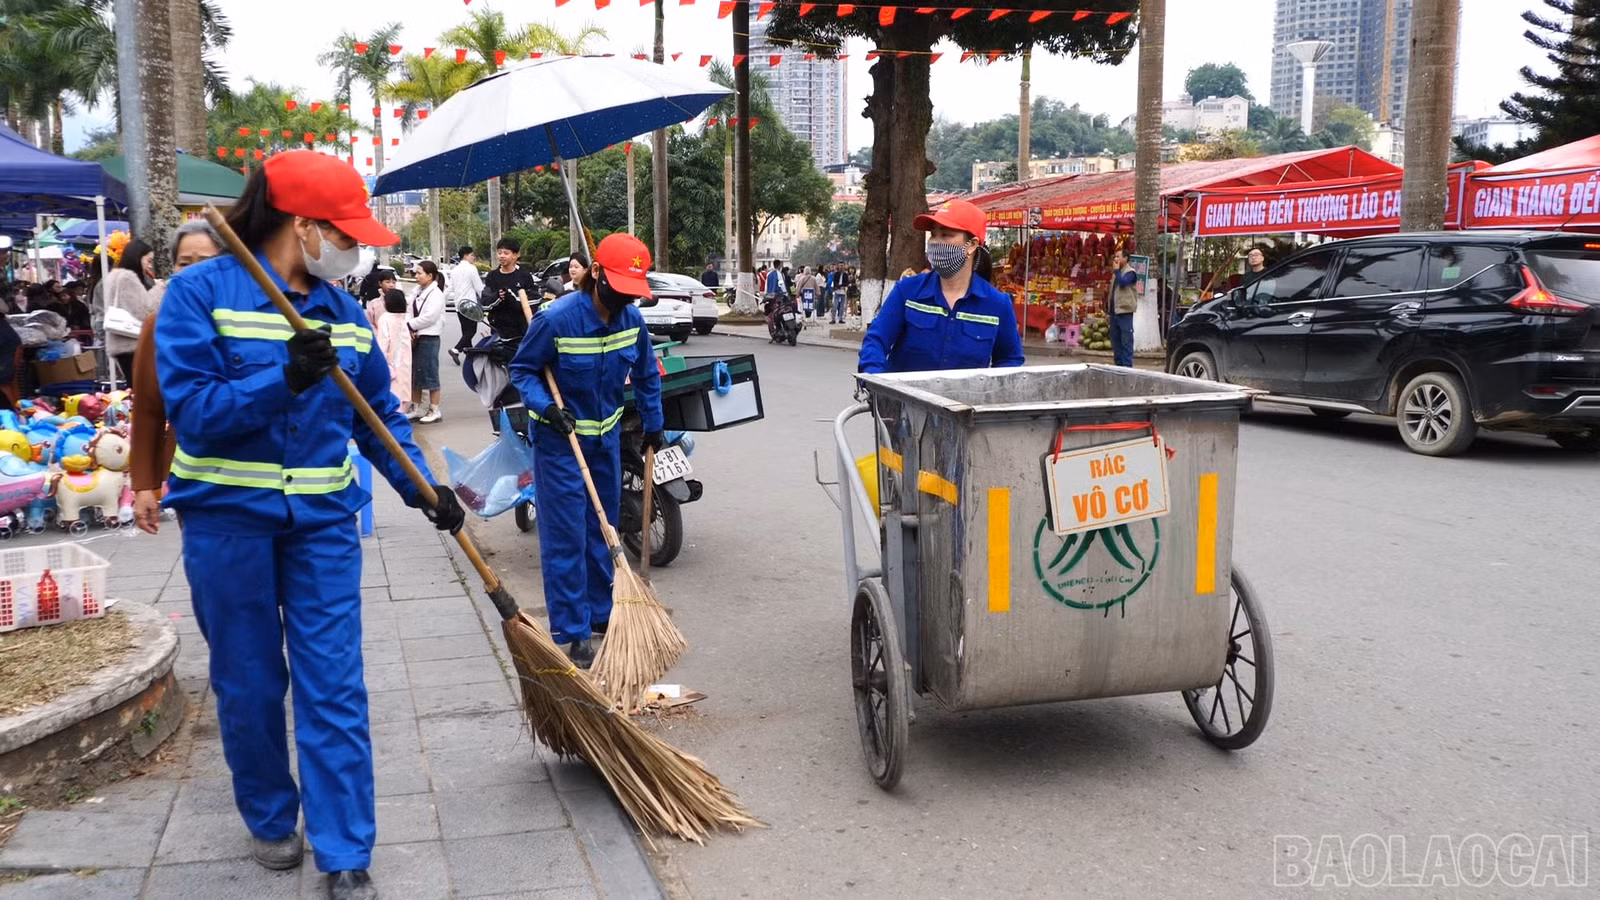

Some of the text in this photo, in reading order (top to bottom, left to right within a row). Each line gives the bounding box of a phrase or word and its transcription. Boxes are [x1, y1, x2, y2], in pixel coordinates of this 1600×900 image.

[1205, 201, 1232, 228] GIAN
[1234, 197, 1266, 226] HÀNG
[1297, 193, 1349, 228] THƯỢNG
[1351, 187, 1379, 219] LÀO
[1474, 187, 1514, 218] GIAN
[1516, 179, 1566, 216] HÀNG
[1089, 453, 1126, 479] RÁC
[1072, 478, 1149, 523] VÔ CƠ
